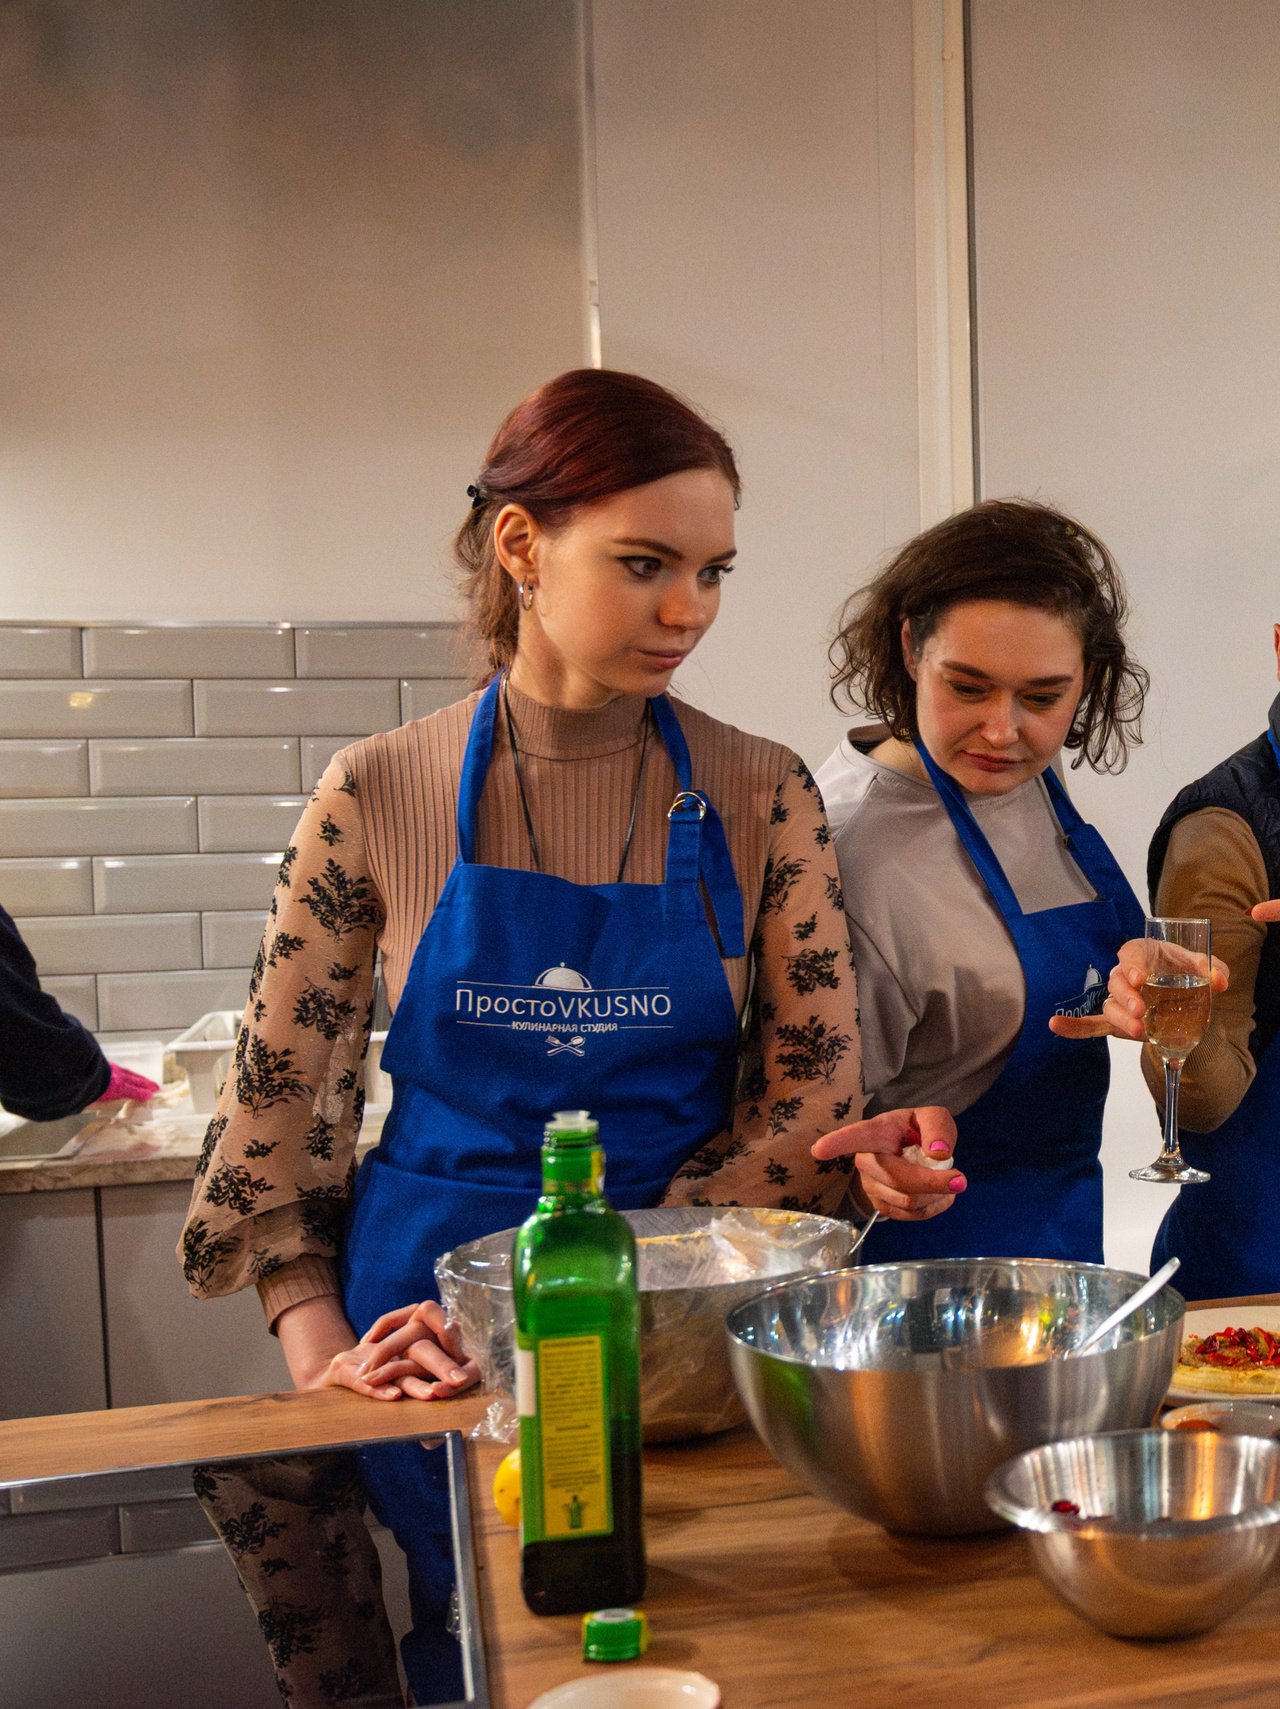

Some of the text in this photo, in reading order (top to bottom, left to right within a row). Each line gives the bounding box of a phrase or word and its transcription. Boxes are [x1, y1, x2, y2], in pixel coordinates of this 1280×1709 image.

[456, 989, 671, 1018] ПростоVKUSNO
[512, 1021, 618, 1033] КУЛИНАРНАЯ СТУДИЯ
